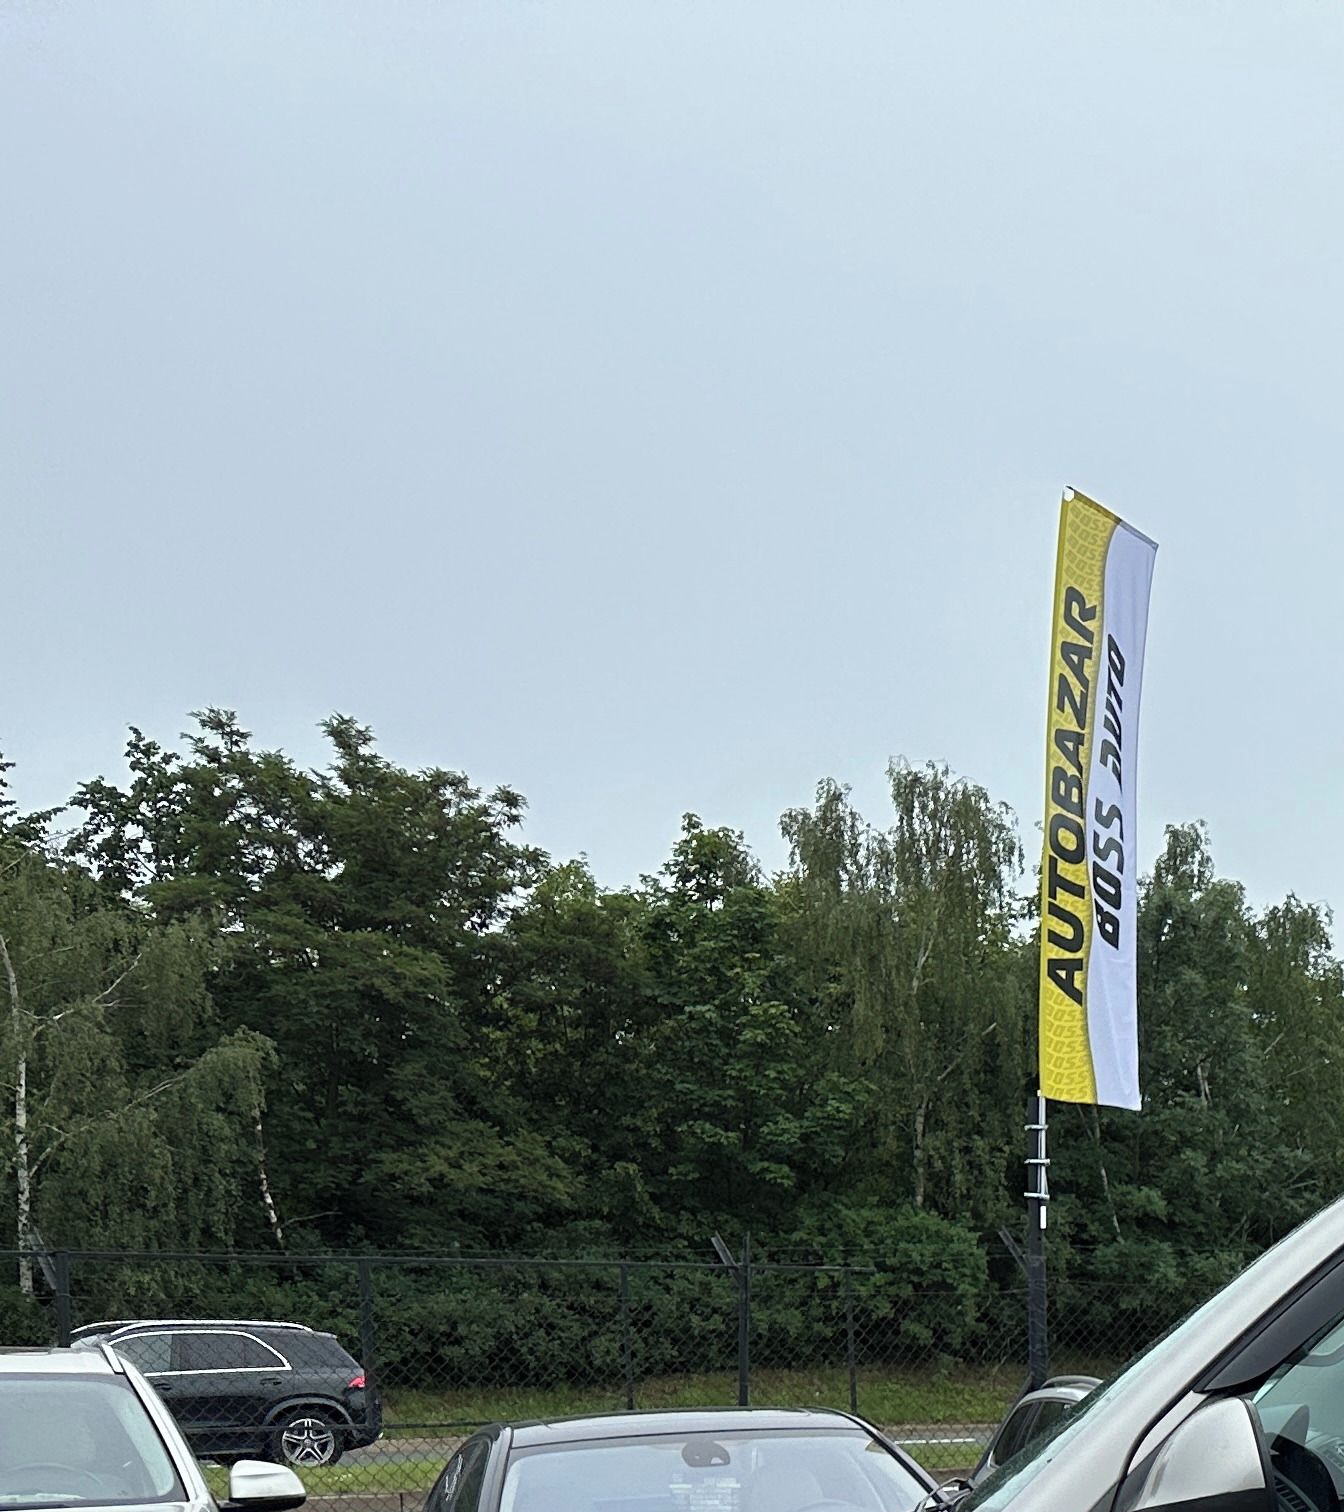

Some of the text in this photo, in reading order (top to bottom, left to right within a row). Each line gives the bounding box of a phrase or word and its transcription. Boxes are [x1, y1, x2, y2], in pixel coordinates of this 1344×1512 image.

[1047, 586, 1098, 1008] AUTOBAZAR
[1092, 633, 1126, 951] BOSS AUTO
